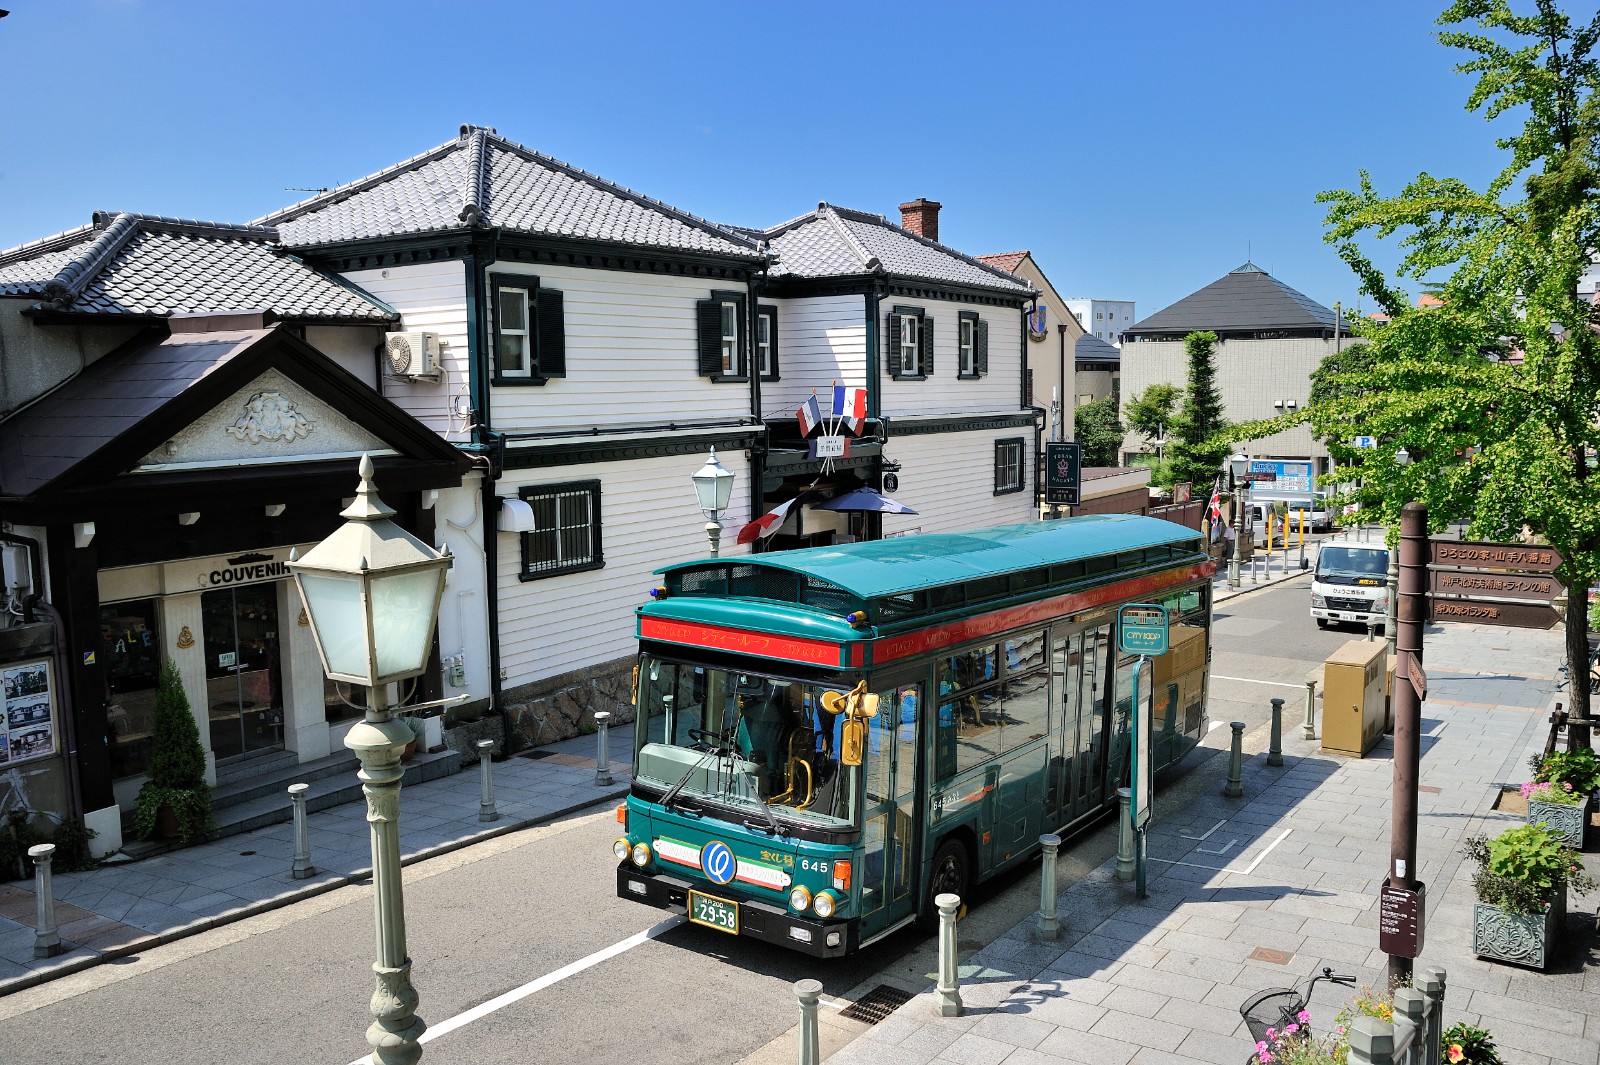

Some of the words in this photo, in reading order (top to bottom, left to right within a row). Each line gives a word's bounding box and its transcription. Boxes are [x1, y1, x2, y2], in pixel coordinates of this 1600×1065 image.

[1361, 437, 1370, 446] P
[802, 859, 828, 873] 645
[700, 903, 735, 928] 29-58
